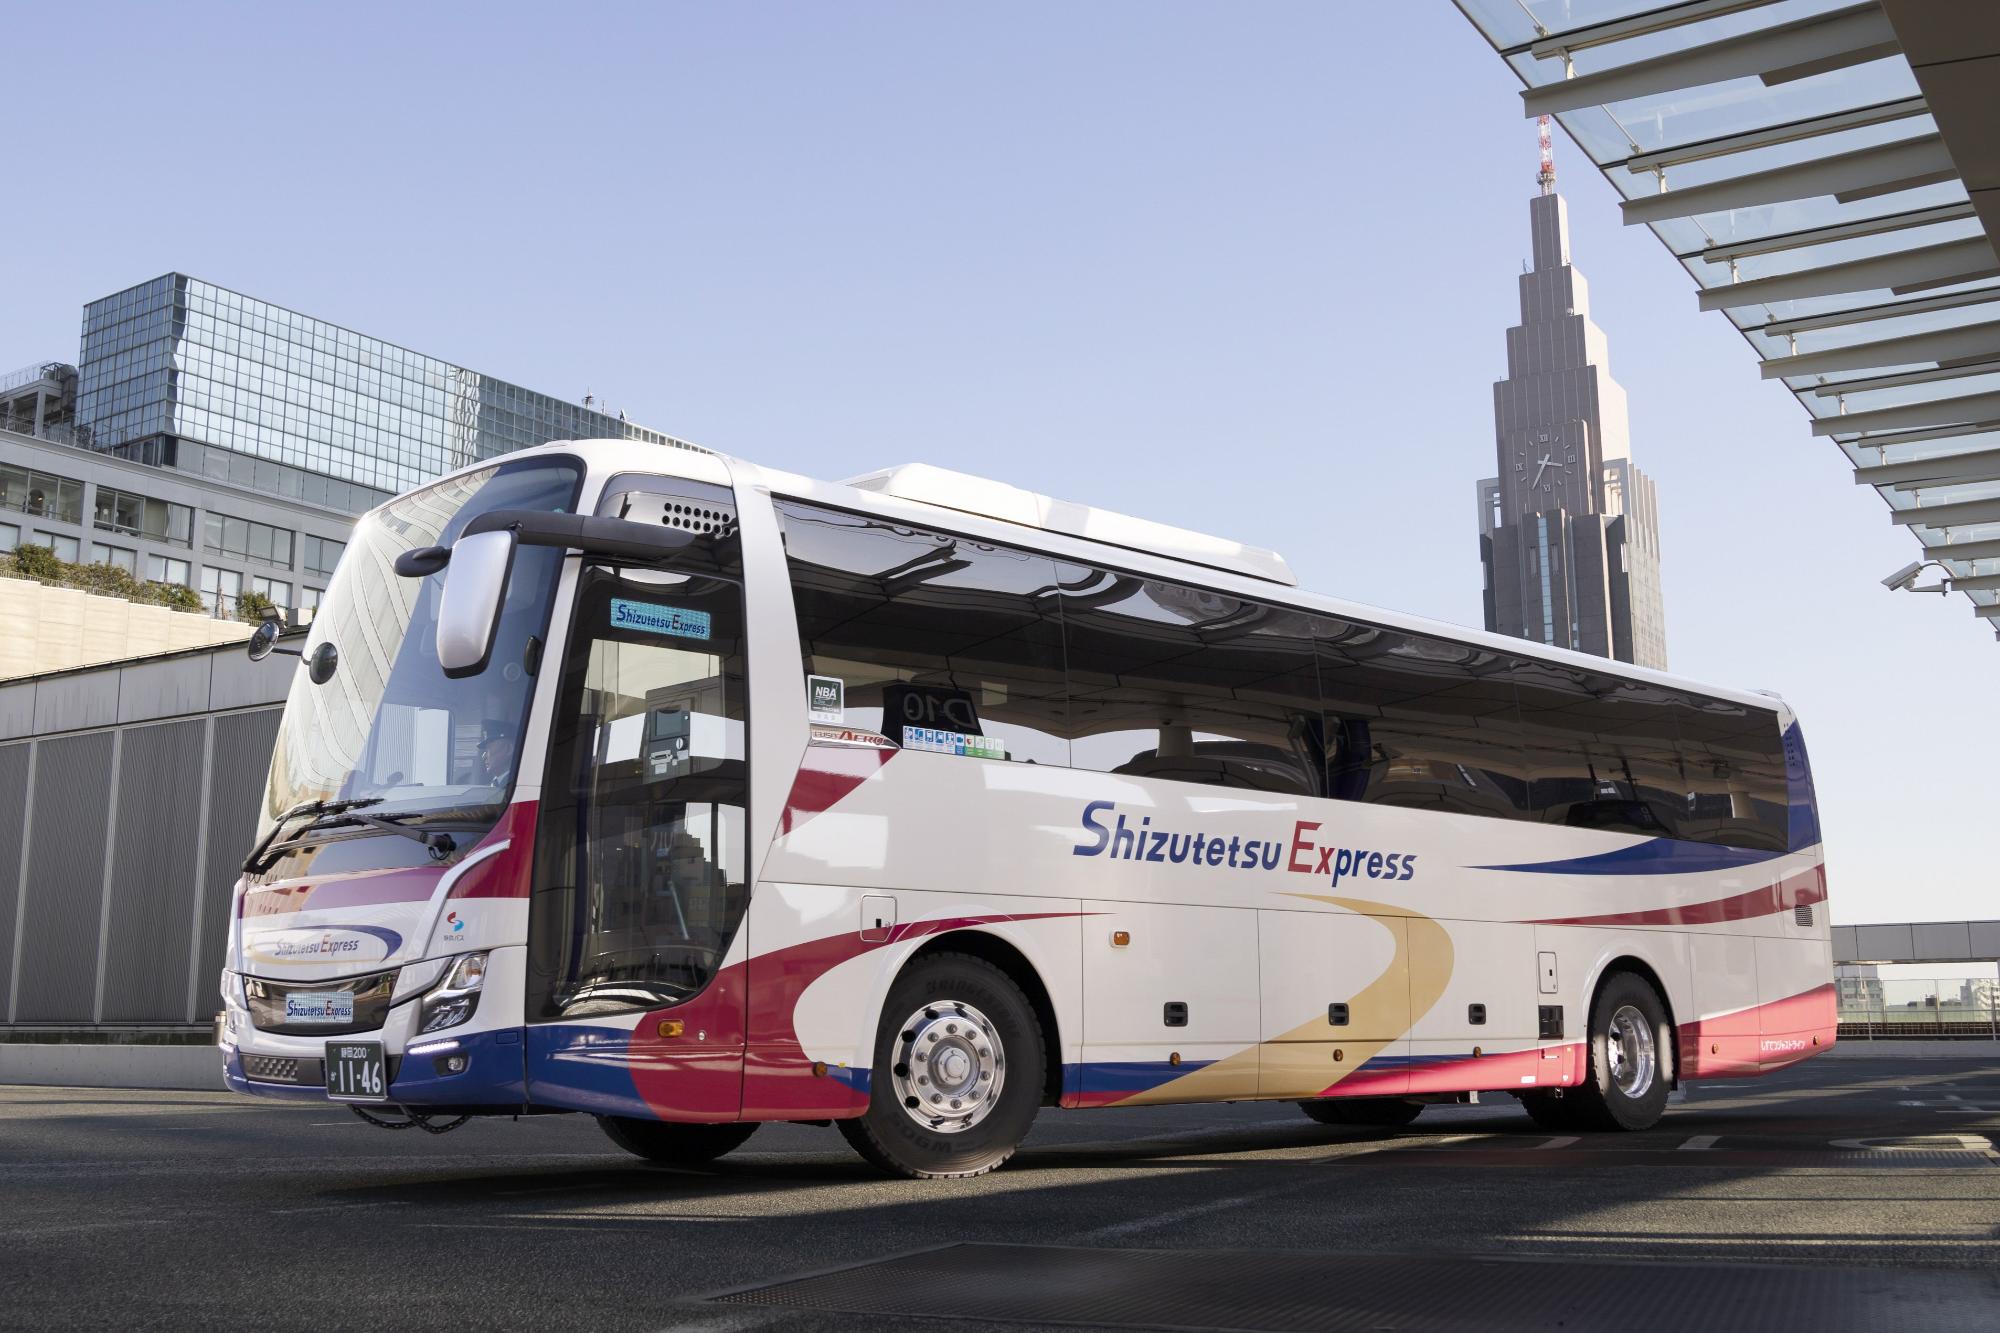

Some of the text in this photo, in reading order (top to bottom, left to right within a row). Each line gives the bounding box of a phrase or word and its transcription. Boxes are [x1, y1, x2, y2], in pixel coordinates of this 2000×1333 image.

[616, 604, 705, 634] Shizutetsu Express
[815, 686, 837, 698] NBA
[1072, 801, 1418, 888] Shizutetsu Express
[274, 933, 360, 956] Shizutetsu Express
[287, 999, 352, 1020] Shizutetsu Express
